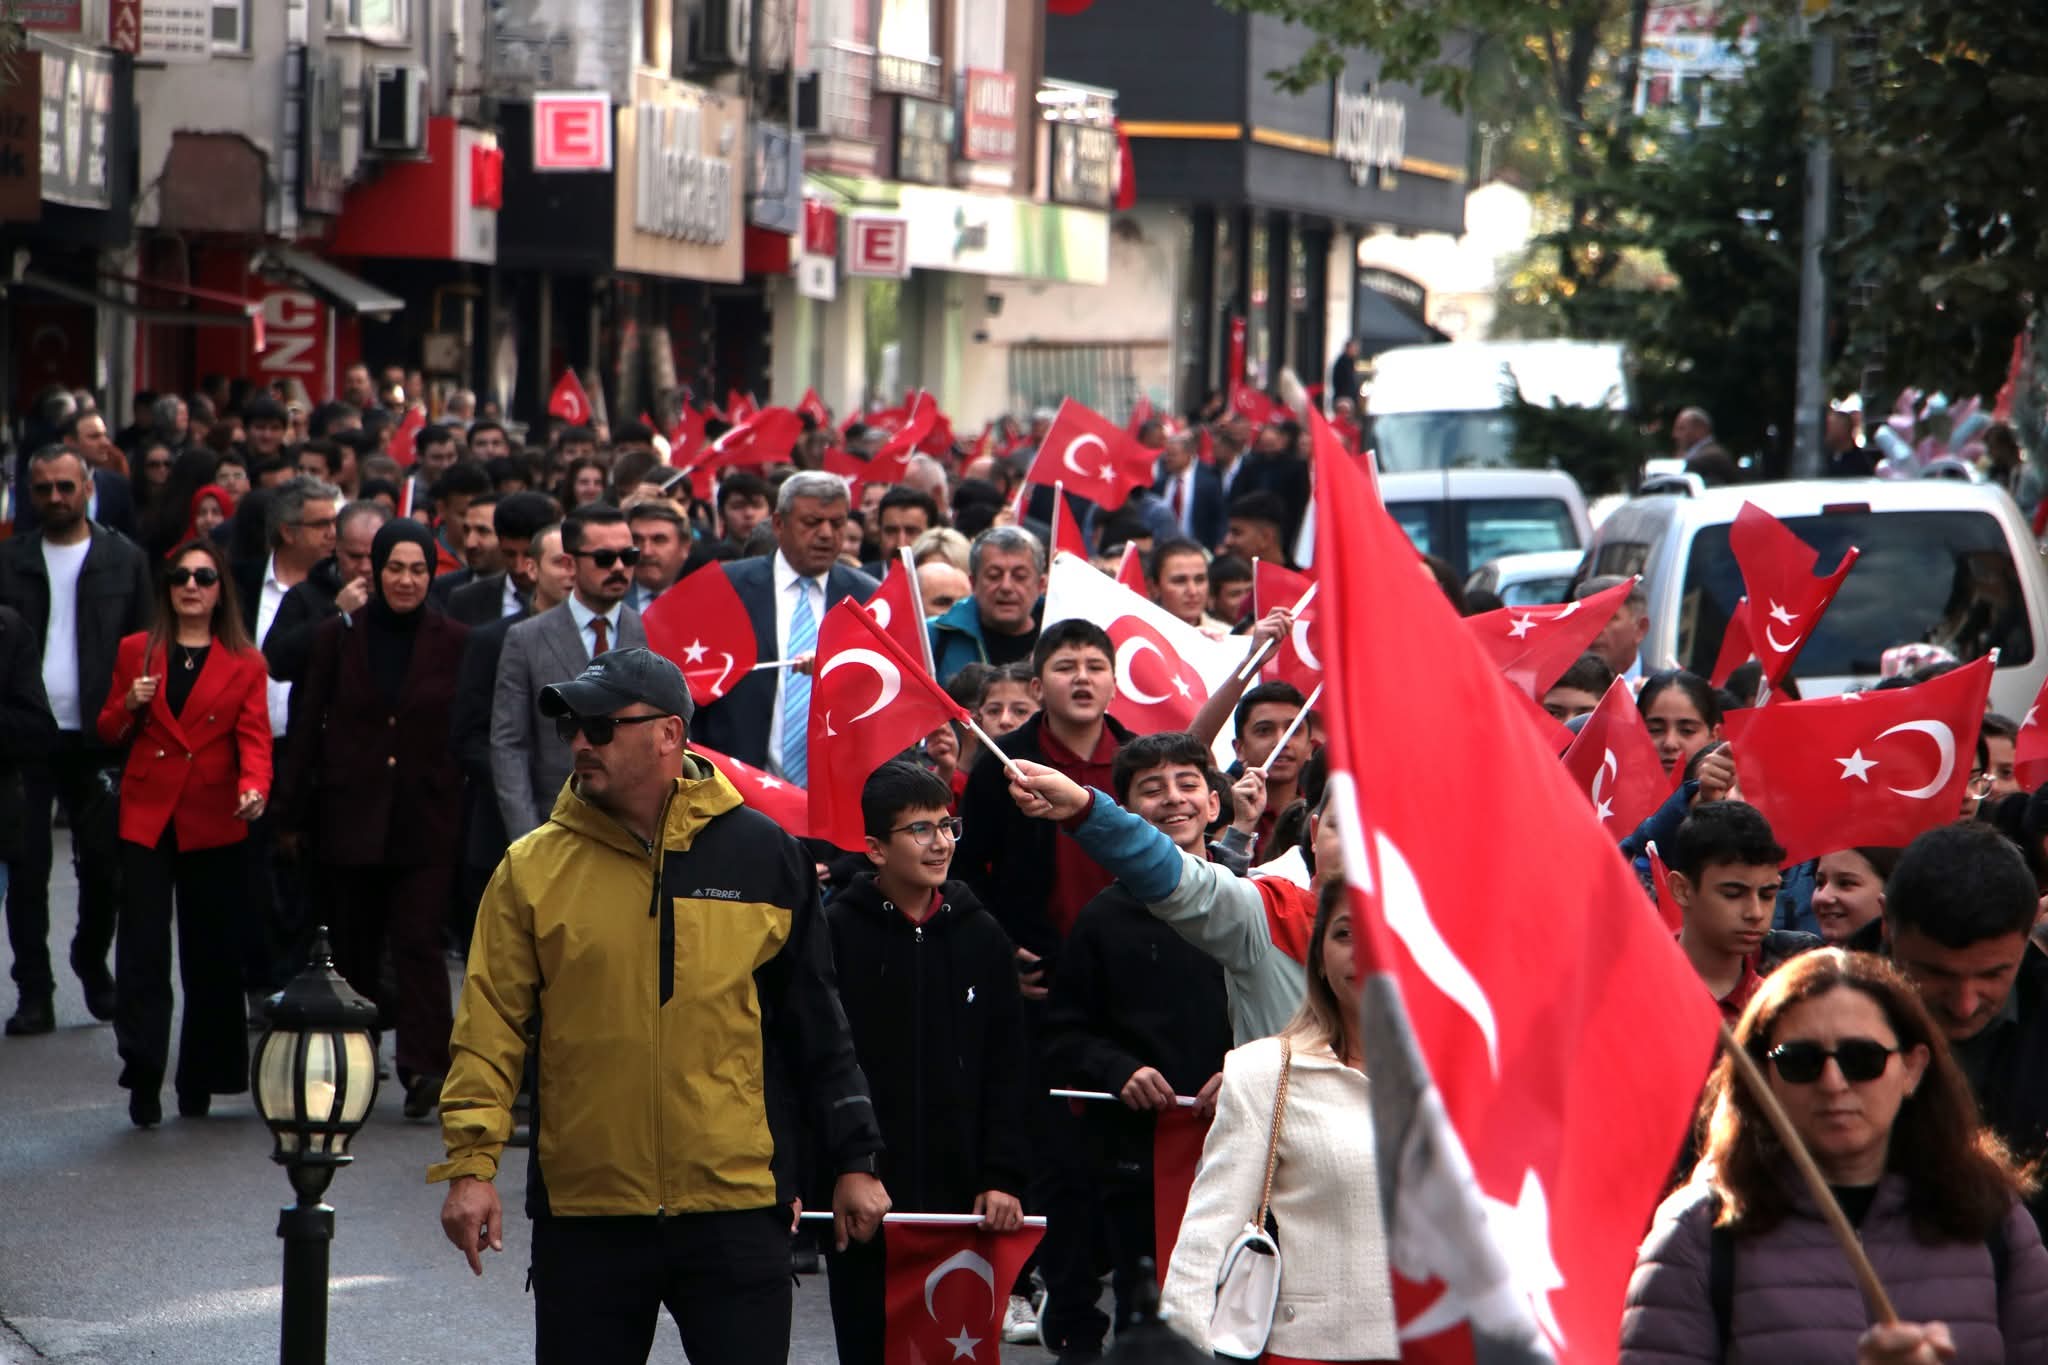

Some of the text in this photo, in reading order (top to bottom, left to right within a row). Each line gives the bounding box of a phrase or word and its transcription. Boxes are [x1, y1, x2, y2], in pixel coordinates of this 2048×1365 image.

[553, 111, 592, 154] E
[864, 228, 895, 263] E
[703, 887, 742, 899] TERREX
